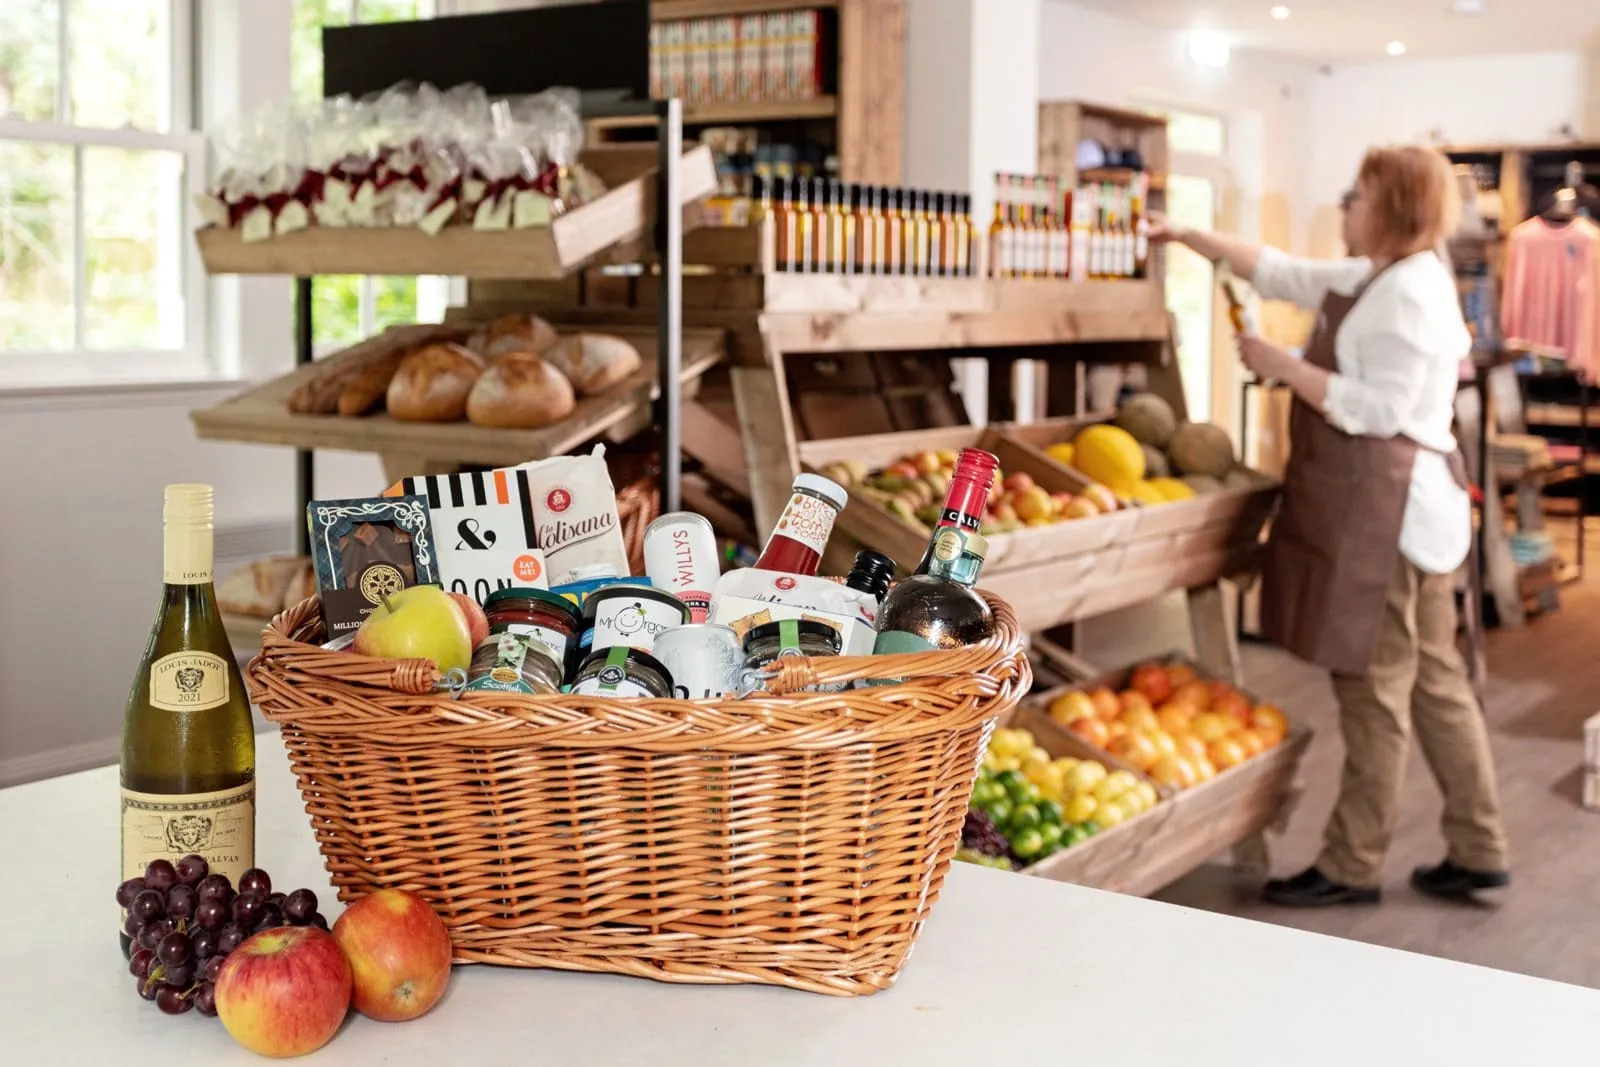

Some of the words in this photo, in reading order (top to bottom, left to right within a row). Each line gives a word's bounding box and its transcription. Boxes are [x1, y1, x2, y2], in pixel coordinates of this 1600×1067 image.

[520, 561, 534, 569] EAT
[183, 571, 207, 579] LOUIS
[520, 568, 535, 576] ME!
[333, 621, 363, 630] MILLIO
[160, 660, 188, 673] LOUIS
[191, 659, 219, 671] JADOT
[178, 692, 201, 703] 2021
